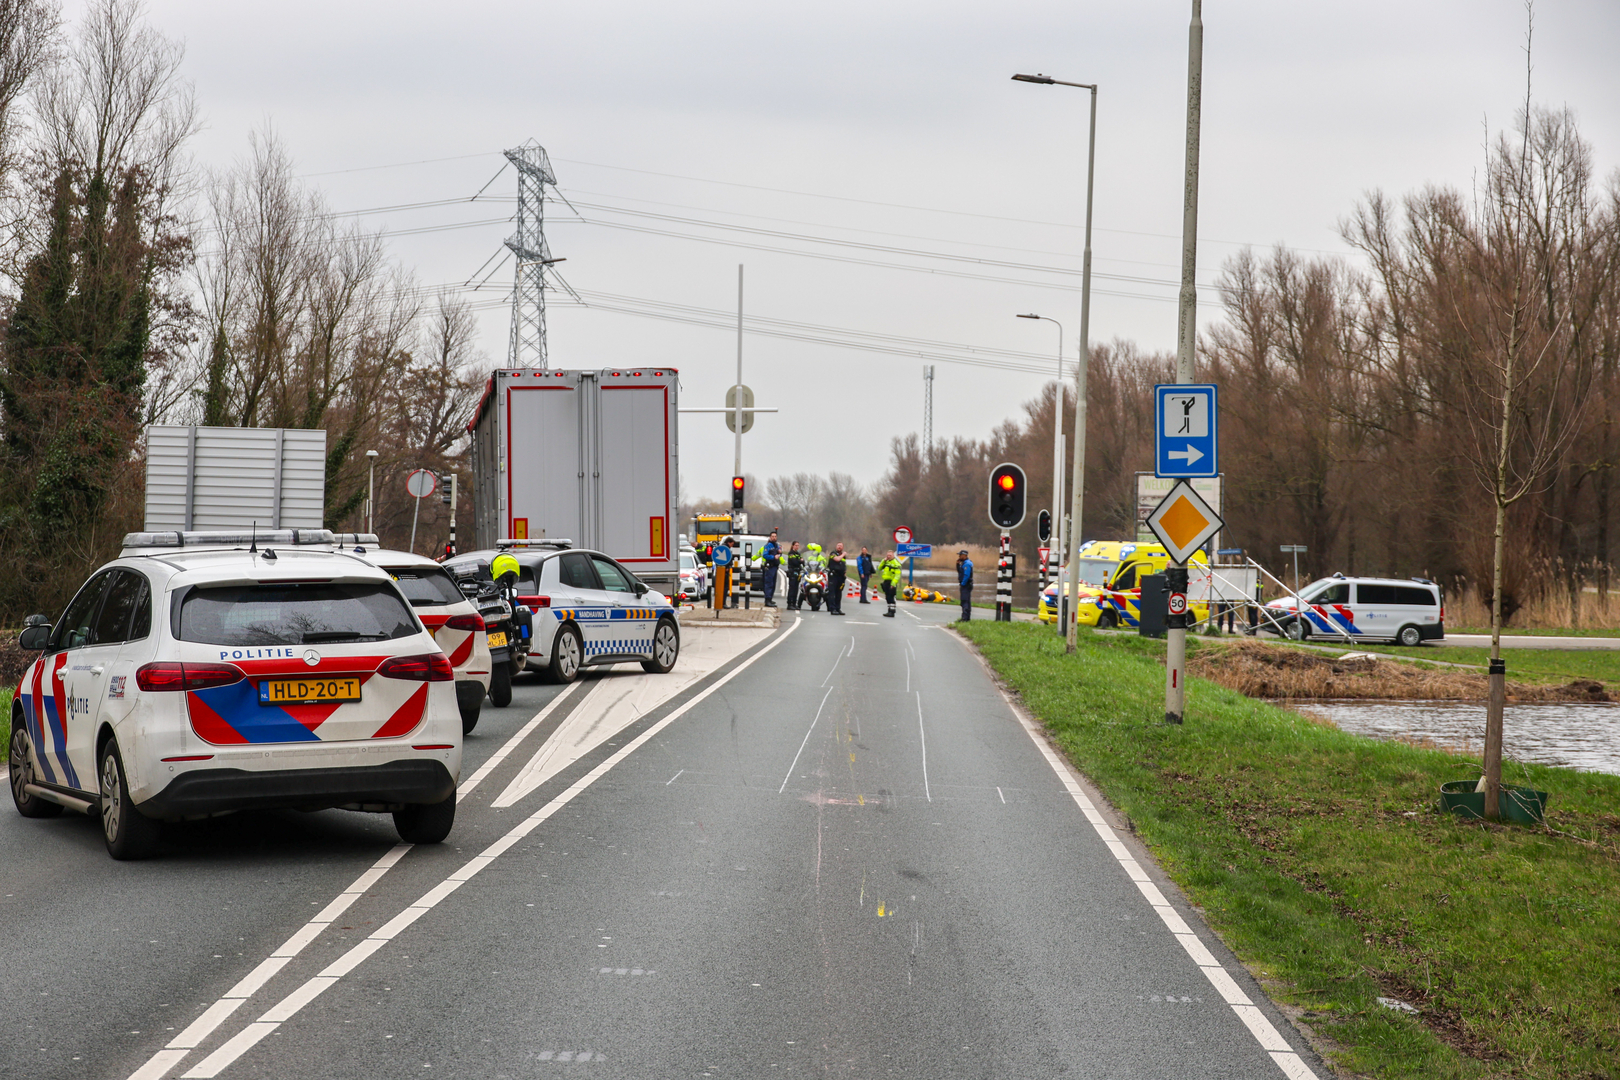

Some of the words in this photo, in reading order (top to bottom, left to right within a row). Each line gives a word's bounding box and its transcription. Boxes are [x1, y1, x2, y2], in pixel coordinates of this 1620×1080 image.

[1171, 599, 1184, 608] 50
[220, 648, 293, 660] POLITIE
[274, 681, 354, 699] HLD-20-T
